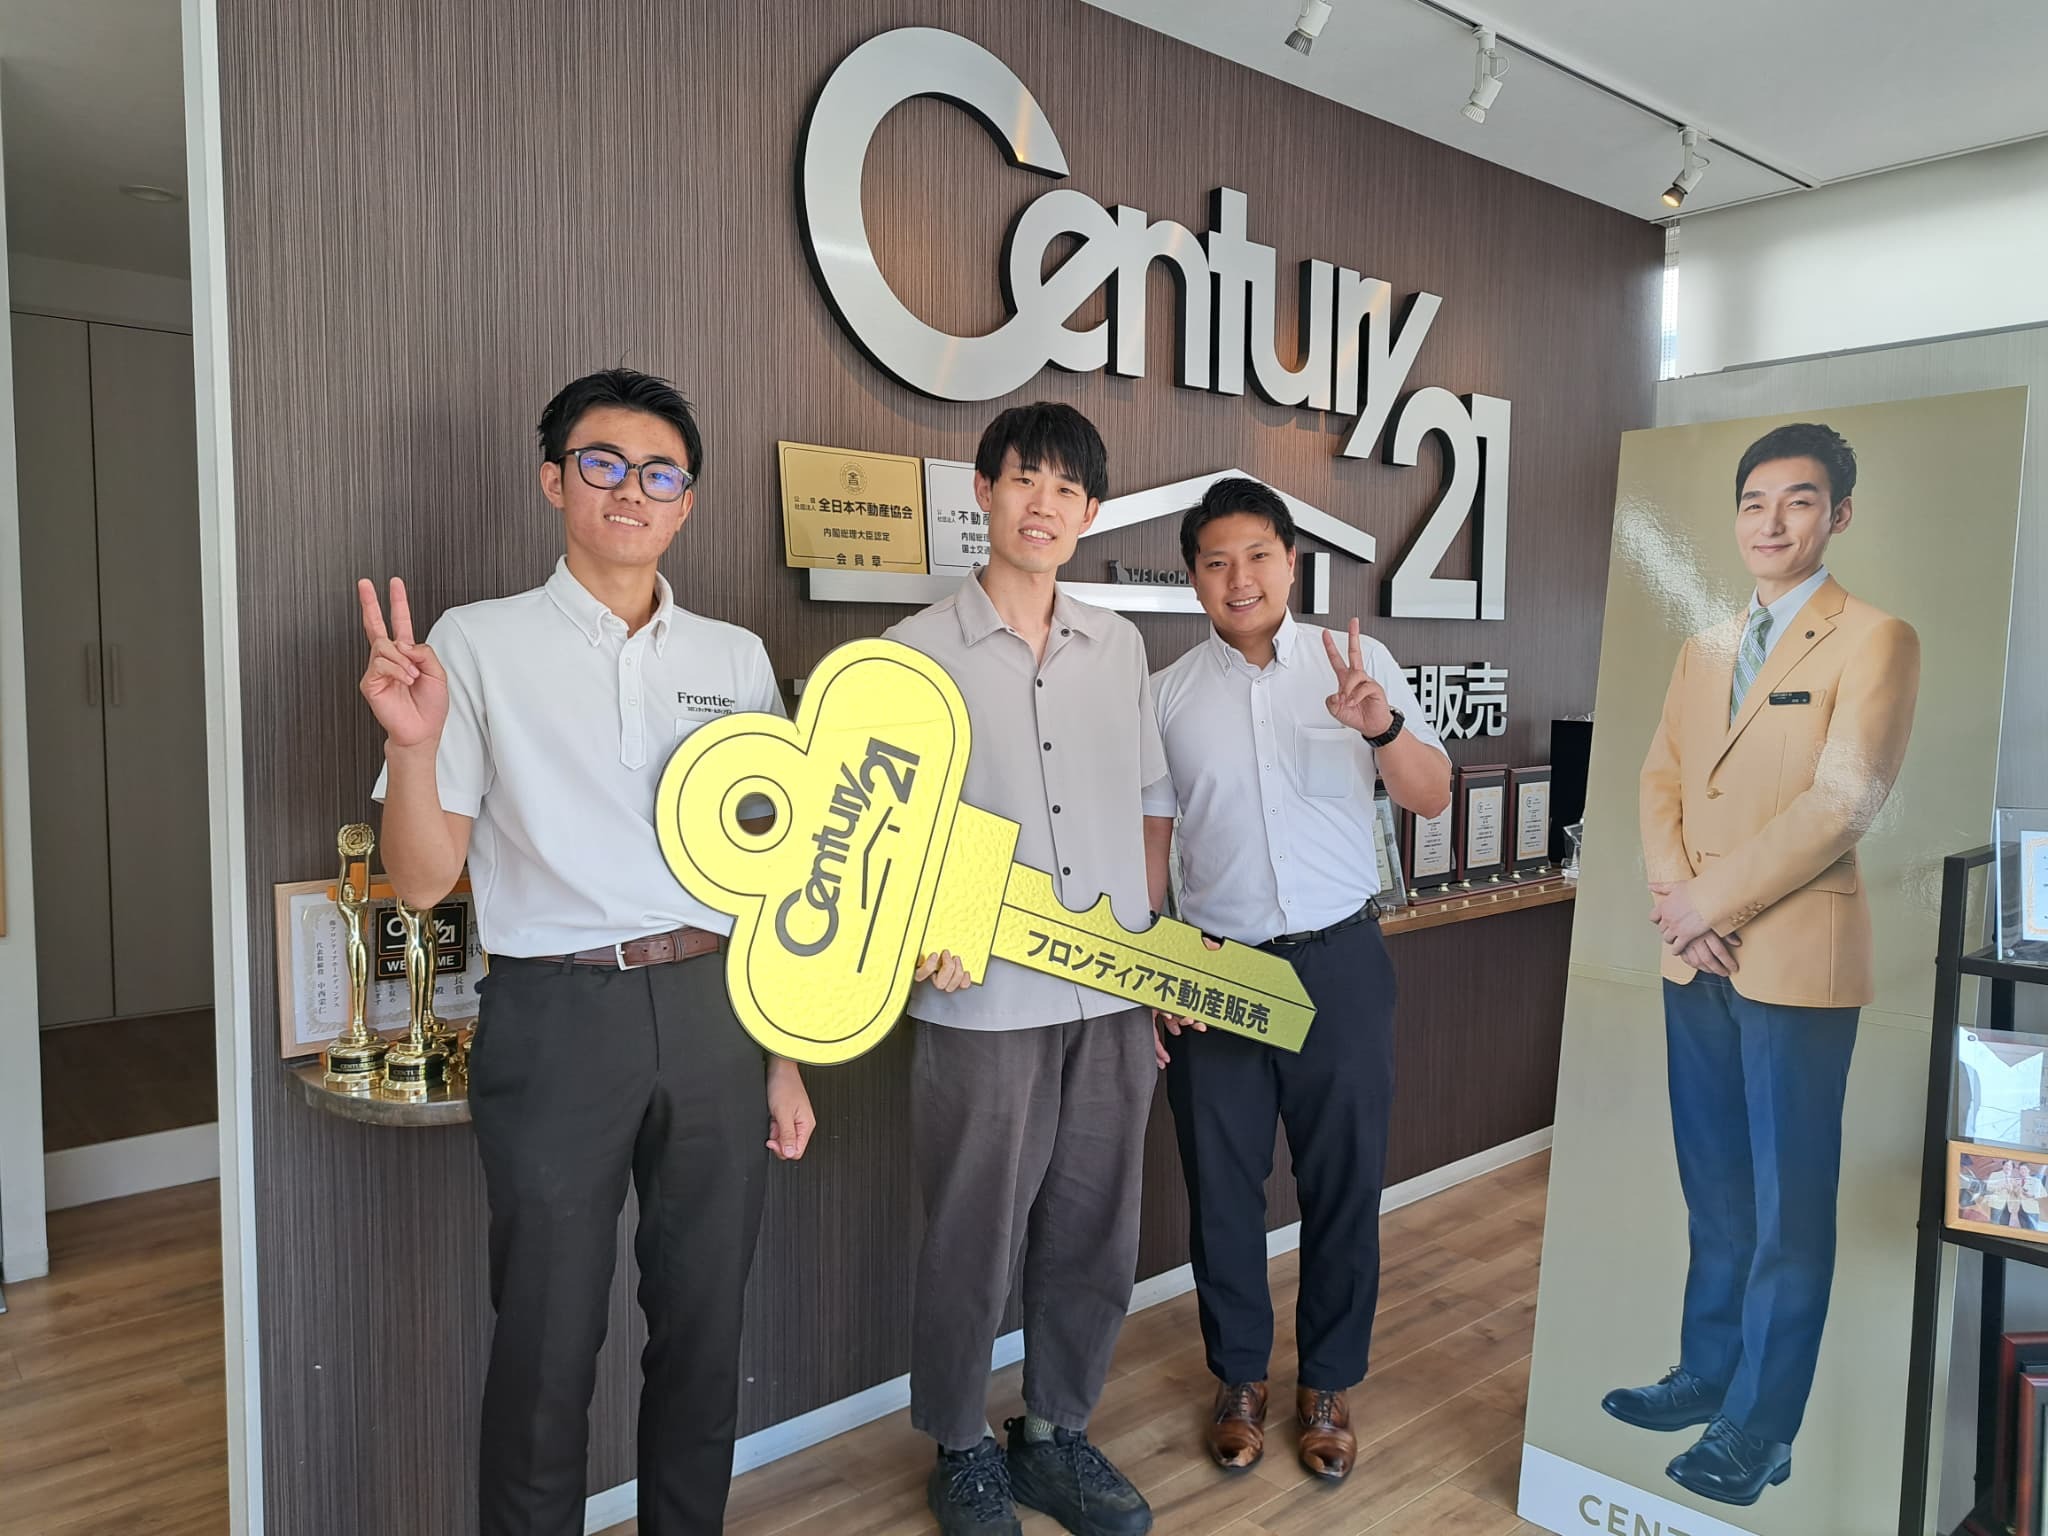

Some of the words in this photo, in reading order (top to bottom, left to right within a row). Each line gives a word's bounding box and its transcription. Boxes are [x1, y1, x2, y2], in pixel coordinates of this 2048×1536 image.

[800, 26, 1443, 458] Century
[1391, 386, 1512, 621] 21
[818, 497, 913, 520] 全日本不動産協会
[775, 761, 871, 957] Century
[859, 737, 920, 804] 21
[438, 924, 456, 944] 21
[386, 955, 455, 972] WEME
[1027, 929, 1271, 1035] フロンティア不動産販売
[1578, 1494, 1694, 1536] CEN
